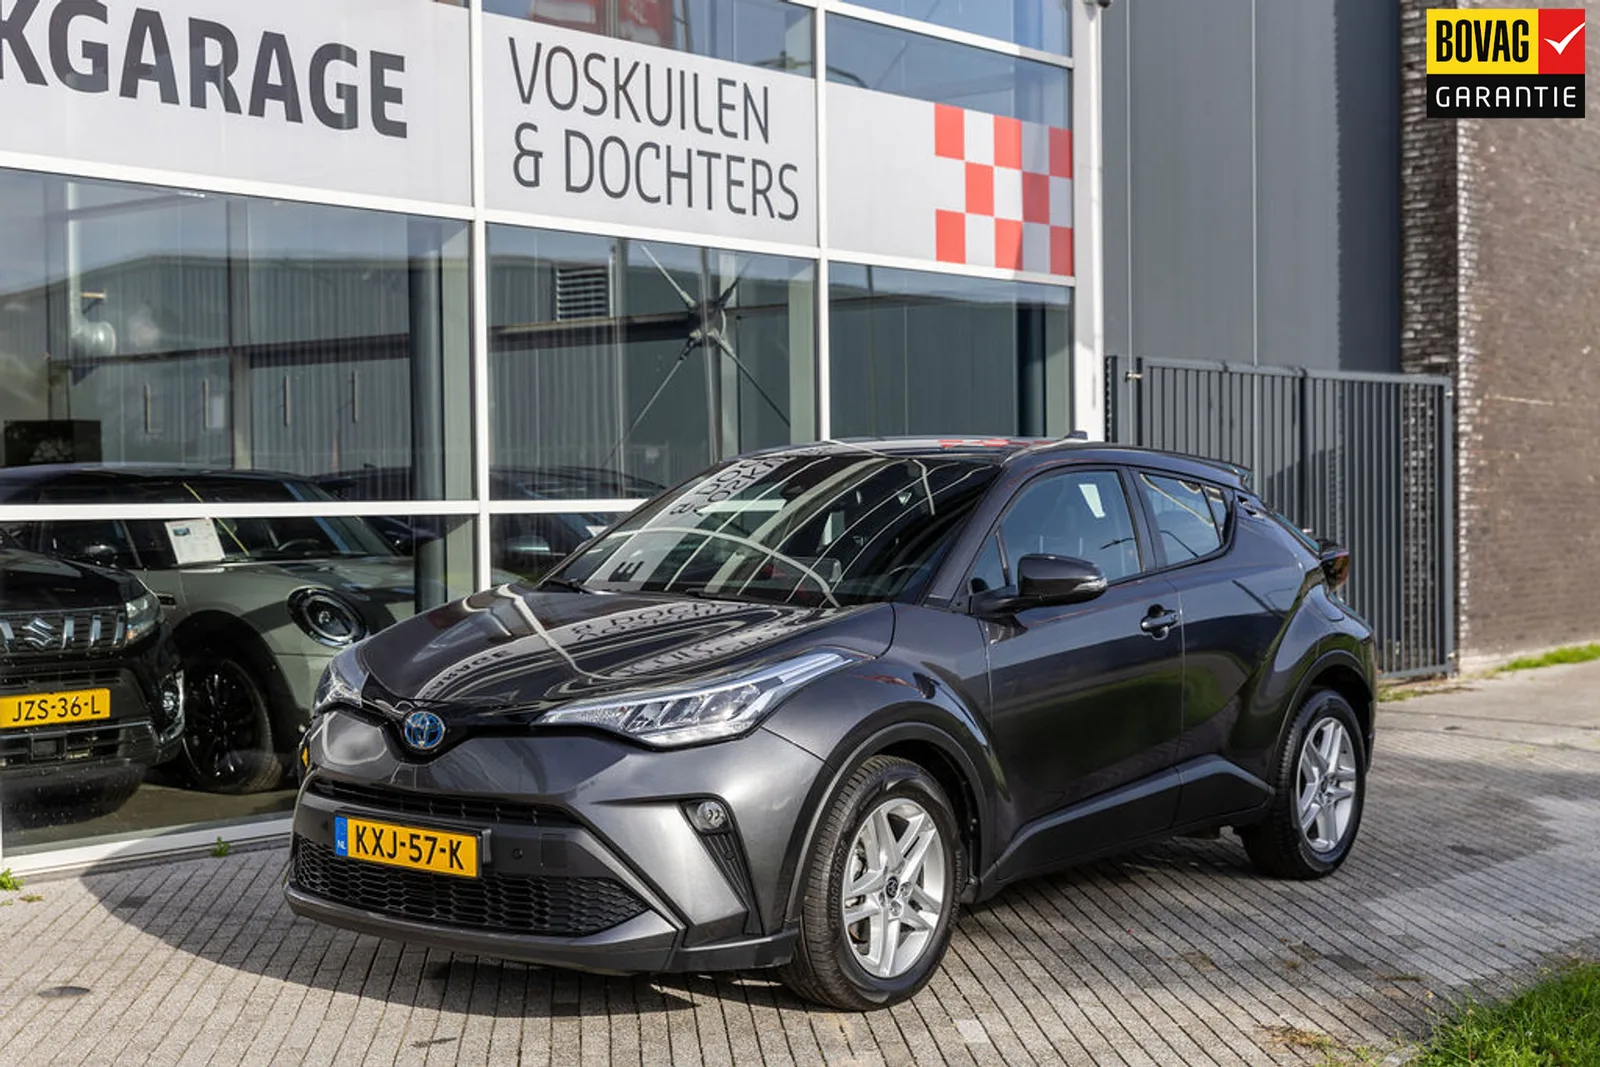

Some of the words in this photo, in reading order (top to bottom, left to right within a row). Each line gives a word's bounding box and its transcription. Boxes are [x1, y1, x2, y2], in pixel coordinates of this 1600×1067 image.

[508, 37, 769, 144] VOSKUILEN
[513, 122, 543, 187] &
[565, 129, 799, 221] DOCHTERS
[12, 695, 101, 722] JZS-36-L
[337, 839, 347, 850] NL
[355, 825, 464, 870] KXJ-57-K
